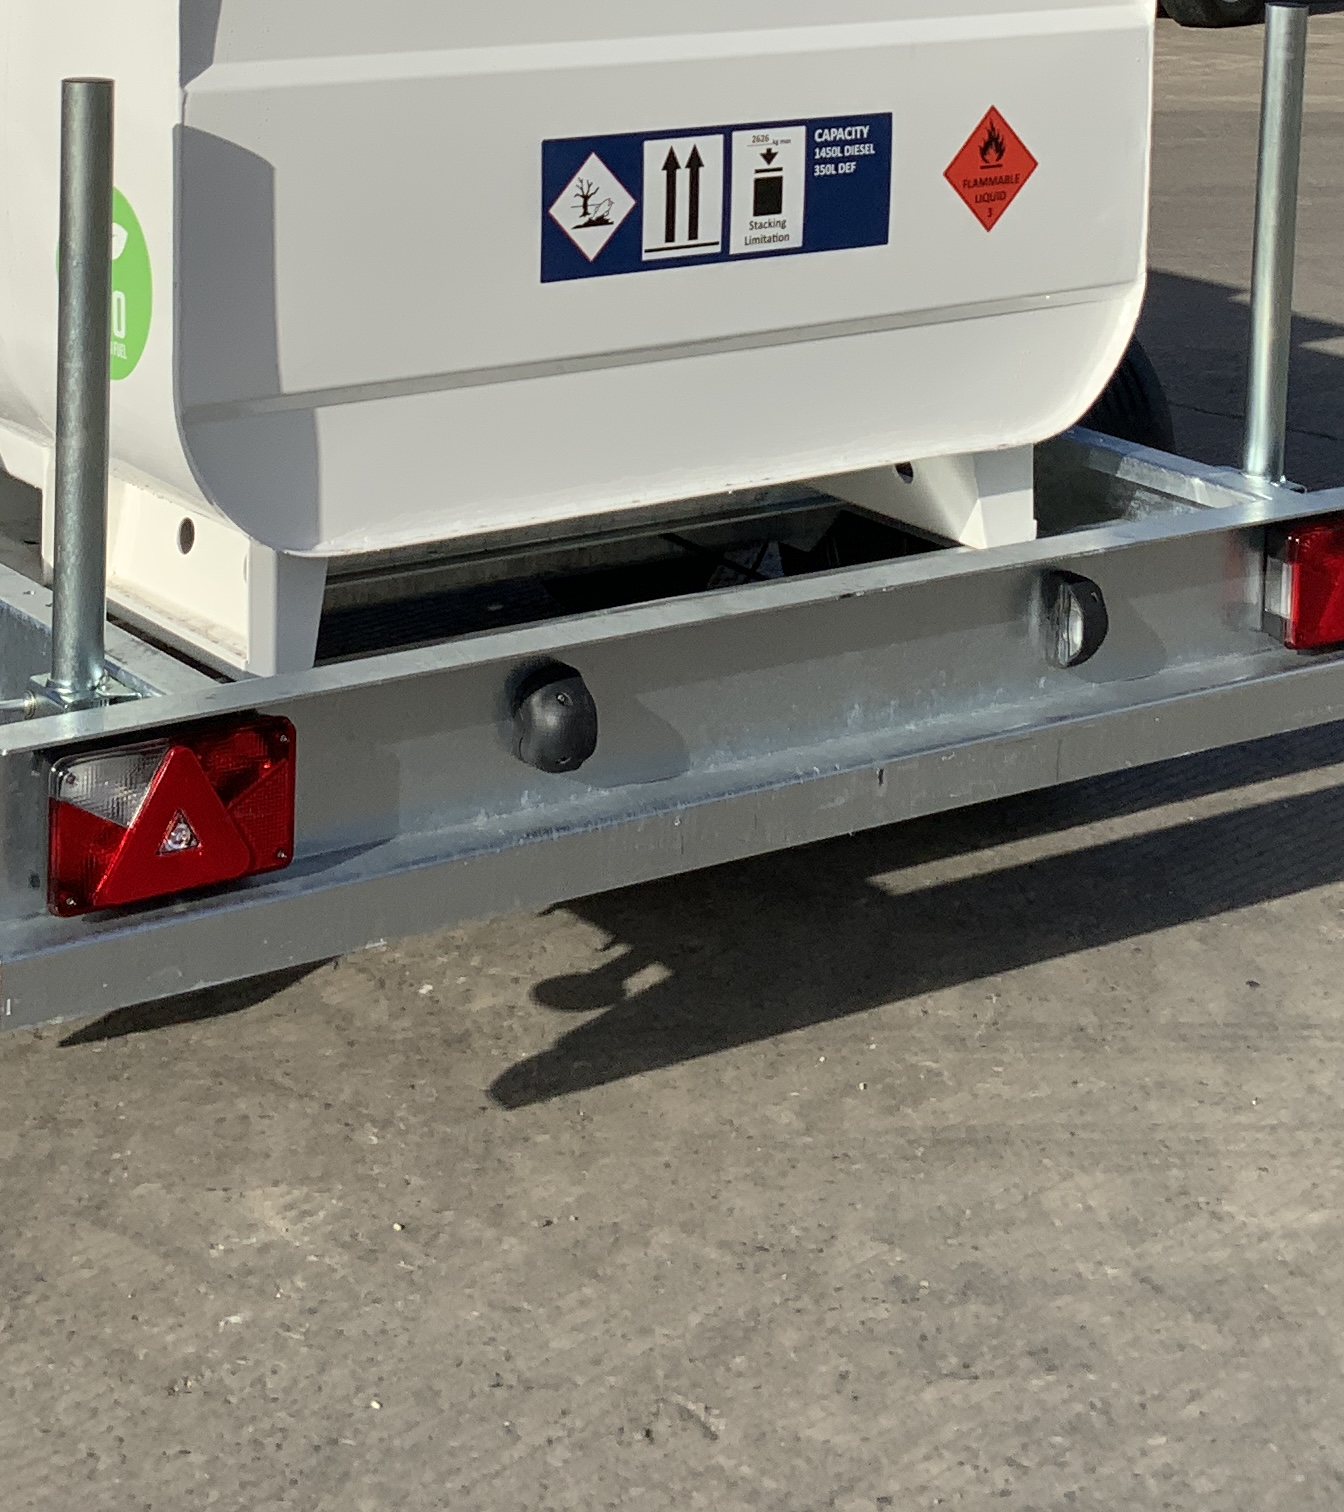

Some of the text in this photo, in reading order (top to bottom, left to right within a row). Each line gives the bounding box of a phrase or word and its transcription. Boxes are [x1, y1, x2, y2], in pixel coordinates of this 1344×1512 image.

[814, 124, 870, 143] CAPACITY
[814, 143, 876, 159] 1450L DIESEL
[813, 161, 857, 177] 350L DEF
[962, 173, 1021, 189] FLAMMABLE
[975, 190, 1007, 204] LIQUID
[748, 218, 787, 231] Stacking
[744, 231, 790, 247] Limitation
